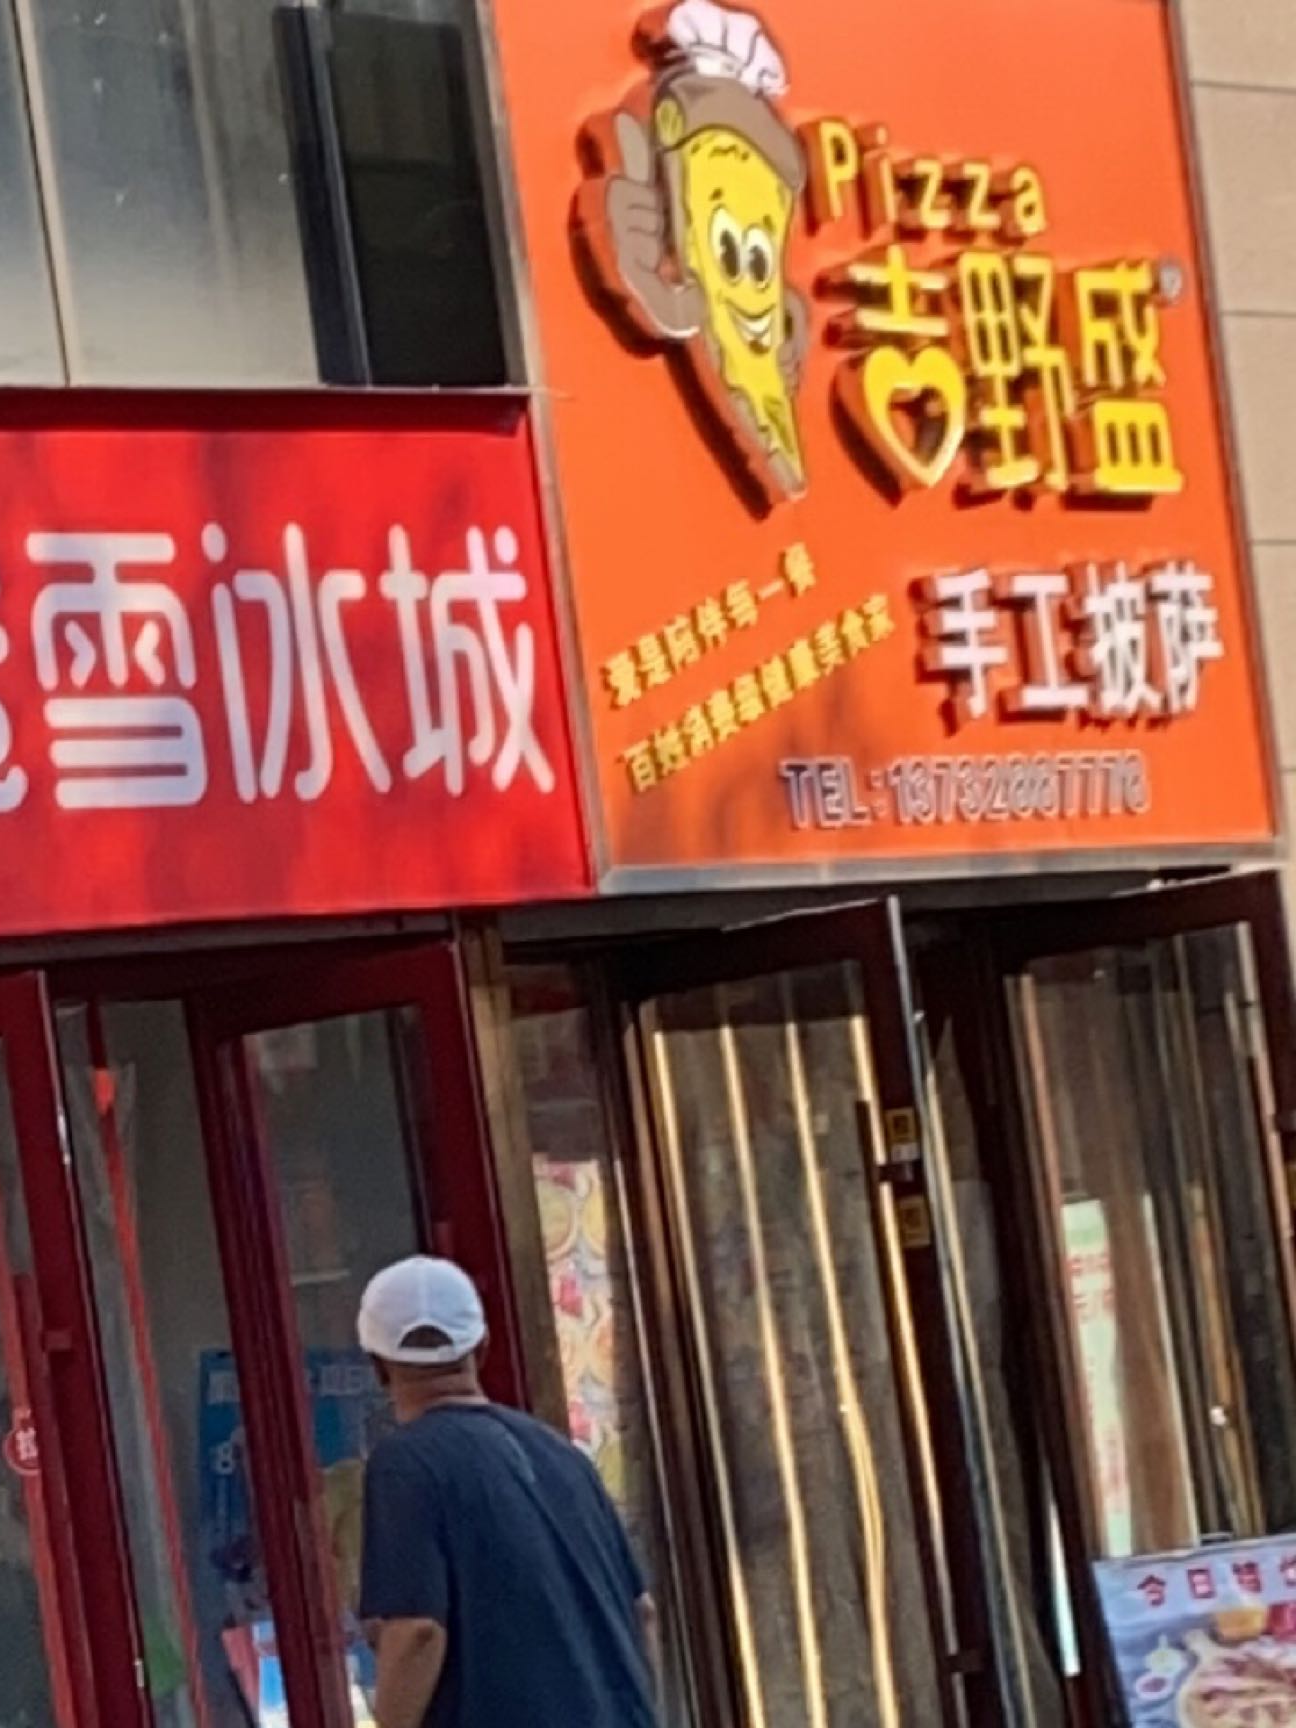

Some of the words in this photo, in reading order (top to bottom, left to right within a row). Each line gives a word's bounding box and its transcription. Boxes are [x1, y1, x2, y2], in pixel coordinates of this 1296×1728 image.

[816, 117, 1048, 236] Pizza
[933, 559, 1226, 719] 手工披萨
